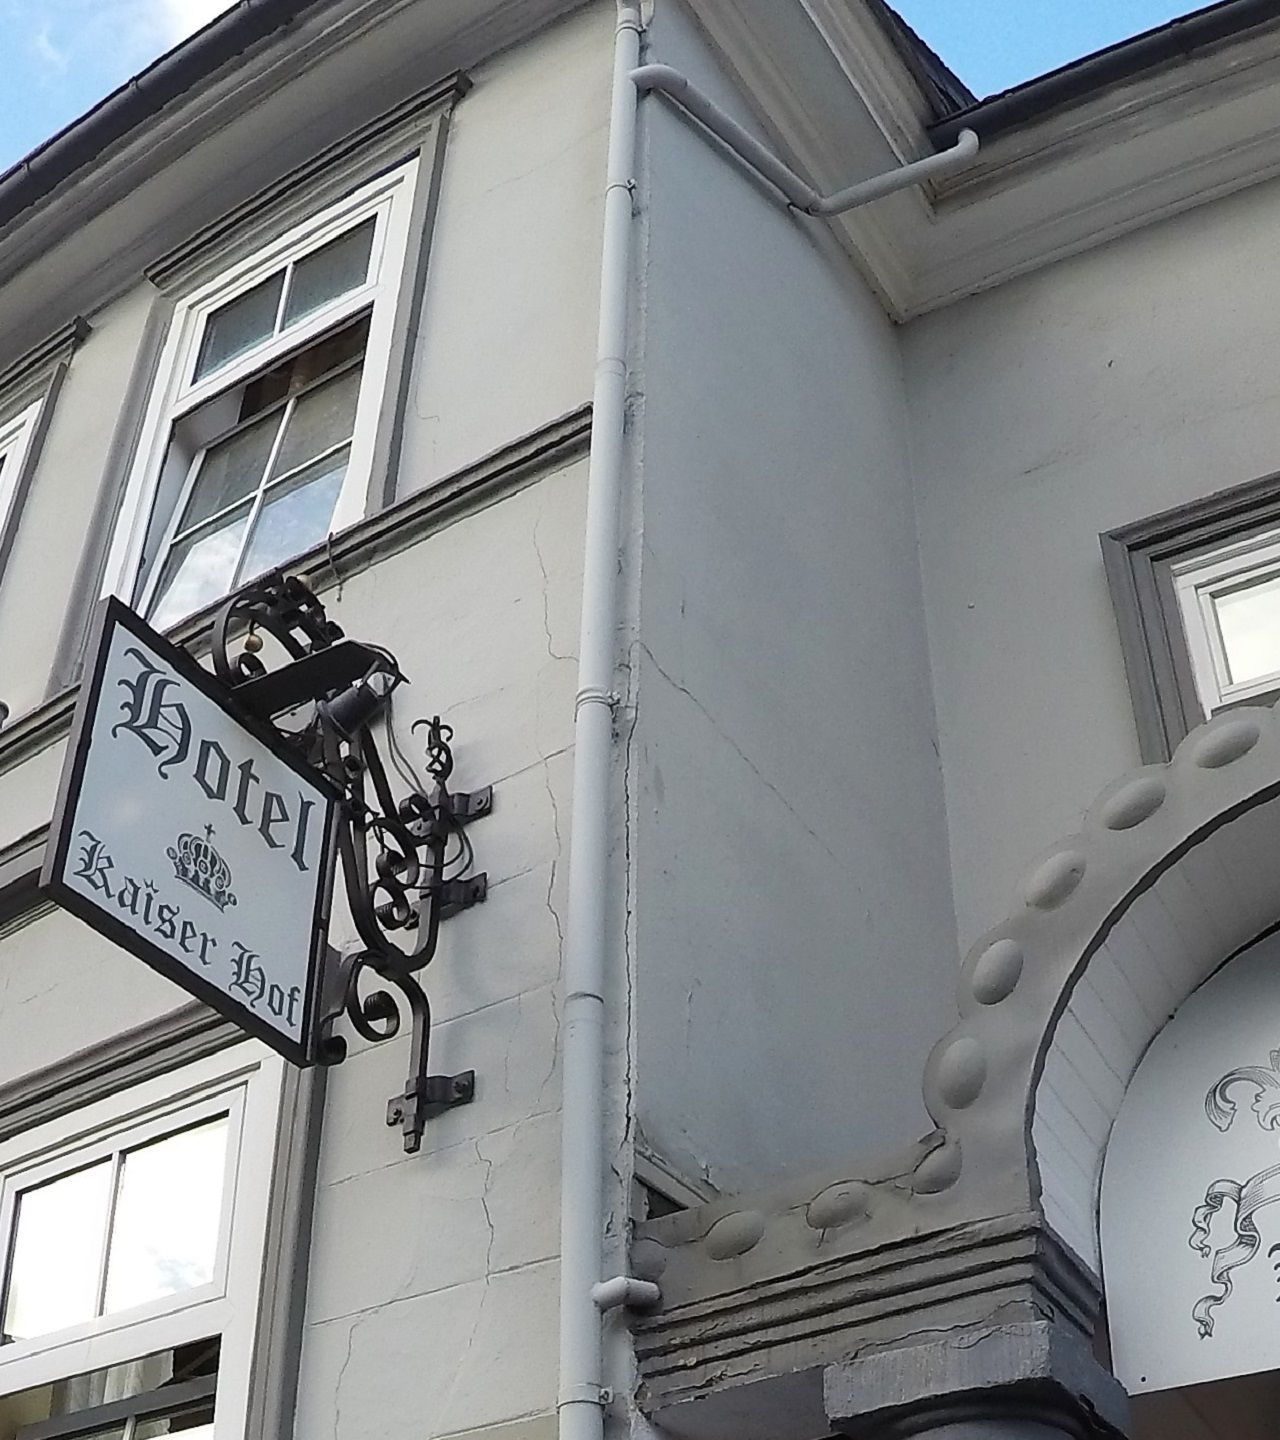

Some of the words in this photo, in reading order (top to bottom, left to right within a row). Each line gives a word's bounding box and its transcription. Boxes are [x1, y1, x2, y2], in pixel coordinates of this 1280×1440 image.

[111, 647, 316, 872] Hotel
[73, 830, 218, 966] Kaiser
[228, 941, 302, 1028] Hof
